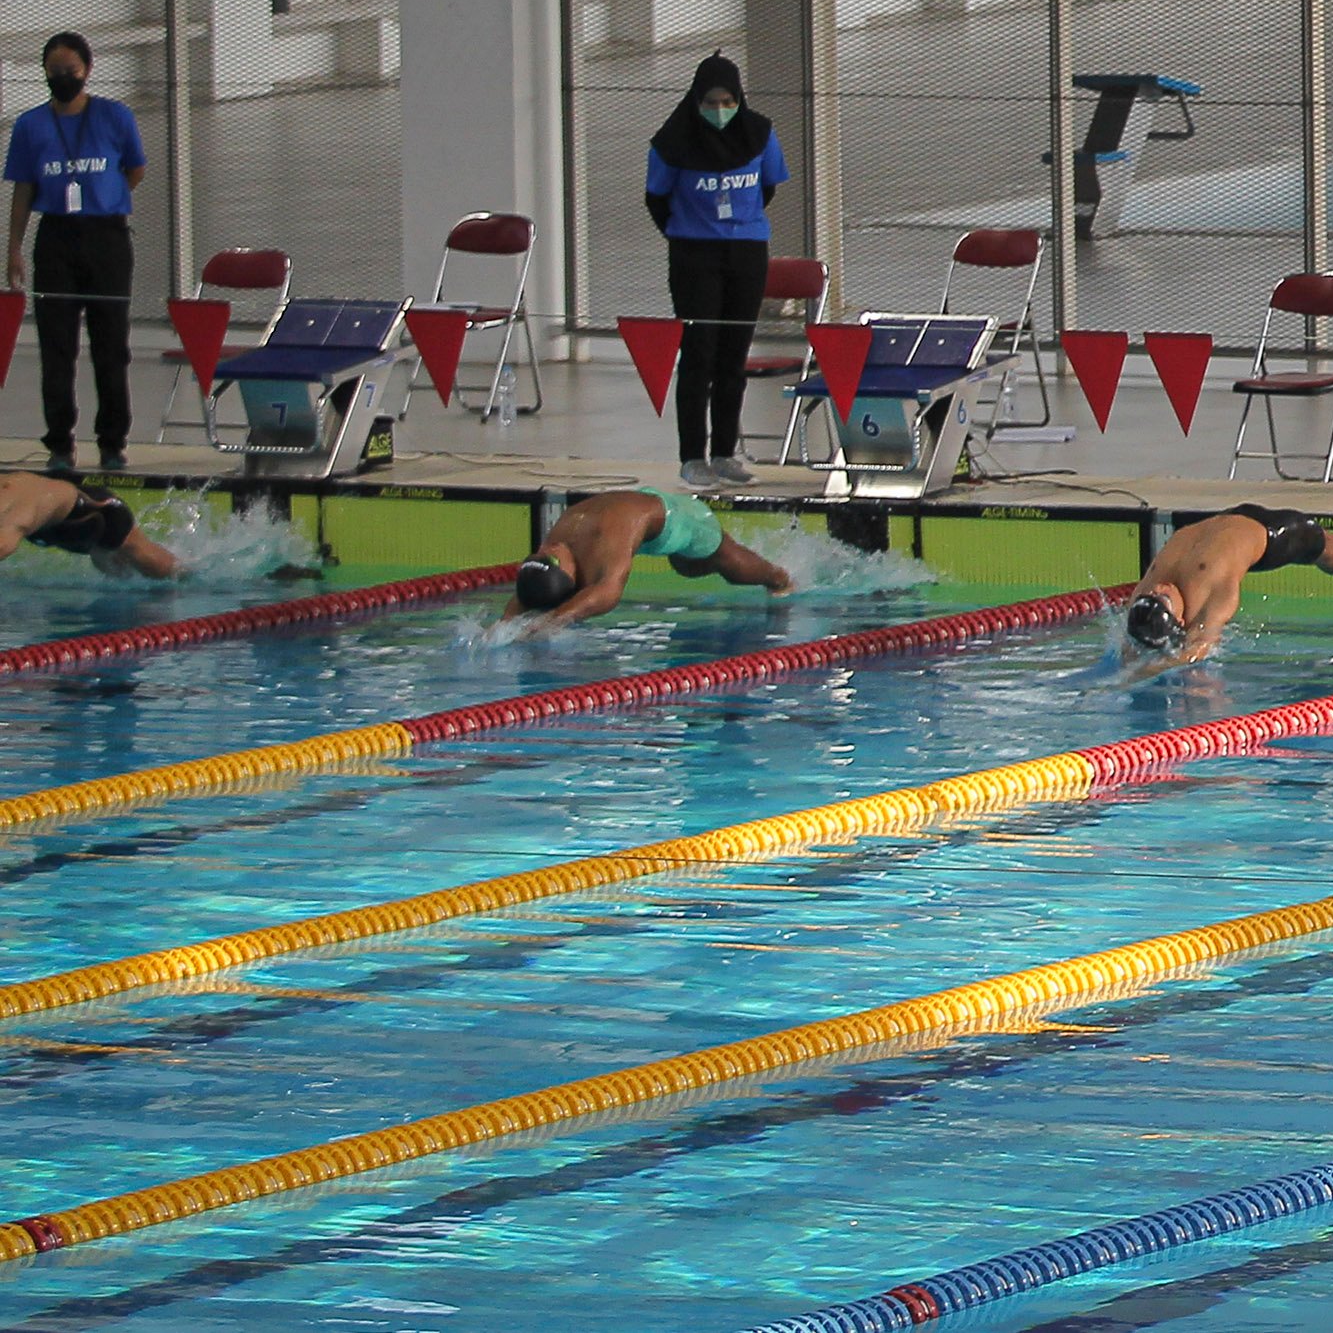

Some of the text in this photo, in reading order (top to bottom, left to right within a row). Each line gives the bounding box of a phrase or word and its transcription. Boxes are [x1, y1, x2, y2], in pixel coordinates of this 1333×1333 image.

[44, 157, 107, 176] AB SWIM
[696, 172, 759, 191] AB SWIM
[271, 402, 288, 427] 7
[862, 412, 881, 439] 6
